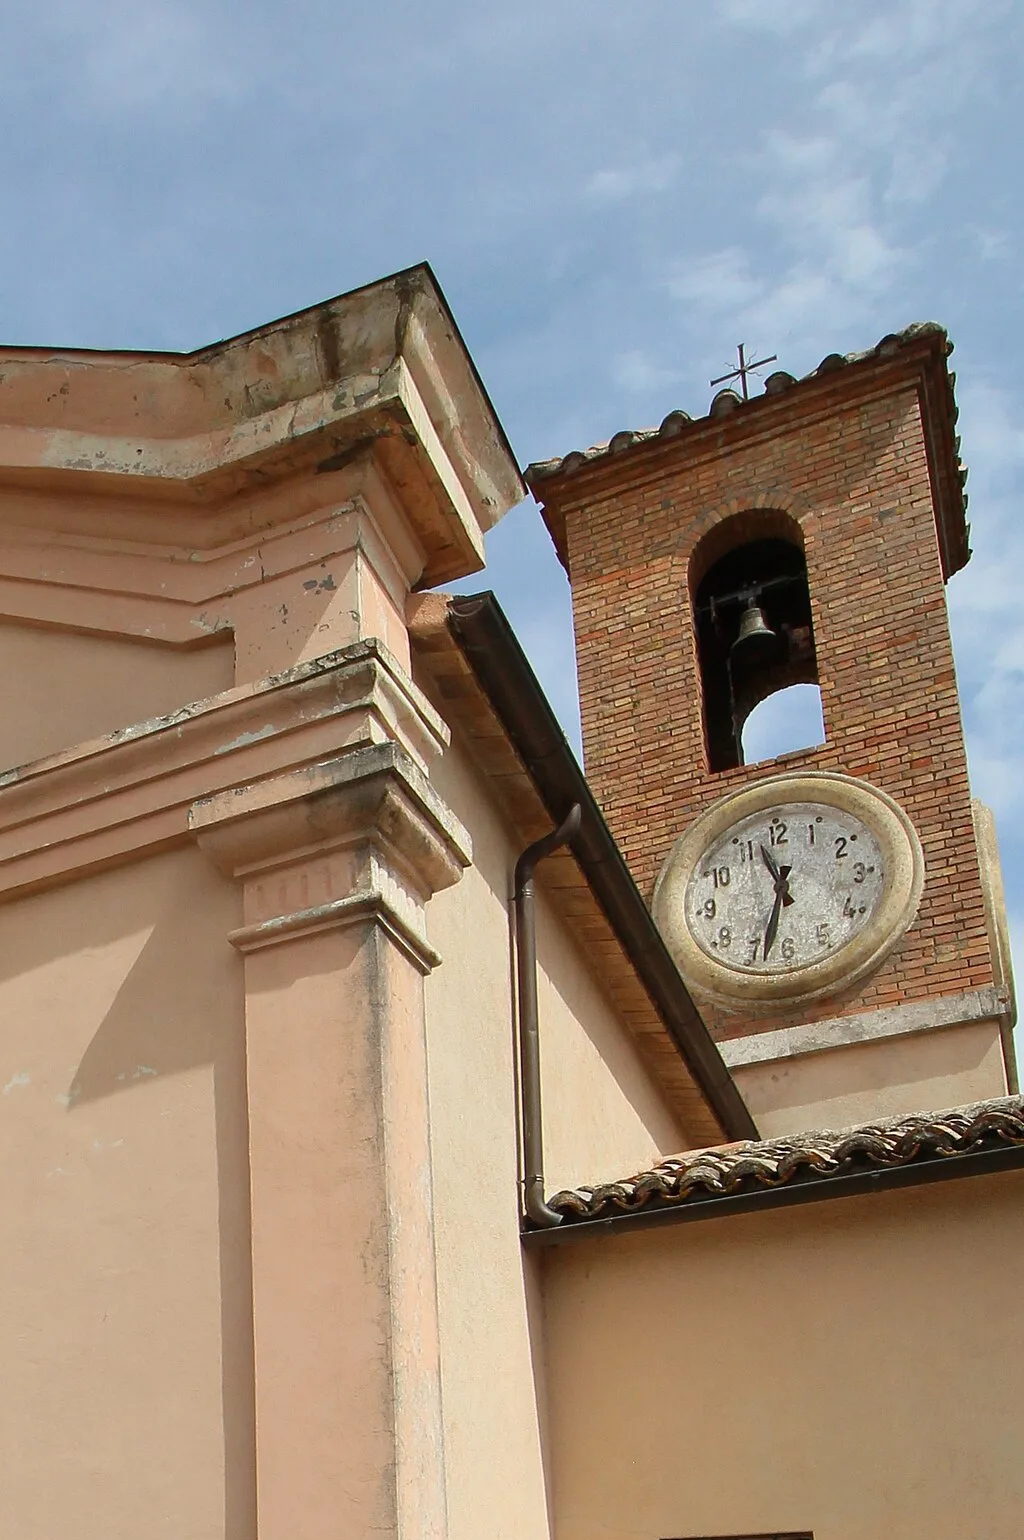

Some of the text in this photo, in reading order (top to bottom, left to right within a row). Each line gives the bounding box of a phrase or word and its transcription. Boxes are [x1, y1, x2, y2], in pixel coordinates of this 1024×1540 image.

[769, 823, 788, 846] 12
[808, 824, 815, 845] 1
[739, 840, 754, 862] 11
[834, 837, 848, 859] 2
[713, 865, 730, 888] 10
[852, 862, 866, 883] 3
[704, 899, 716, 919] 9
[843, 897, 857, 919] 4
[719, 926, 732, 947] 8
[816, 923, 830, 945] 5
[749, 938, 761, 960] 7
[781, 937, 795, 959] 6
